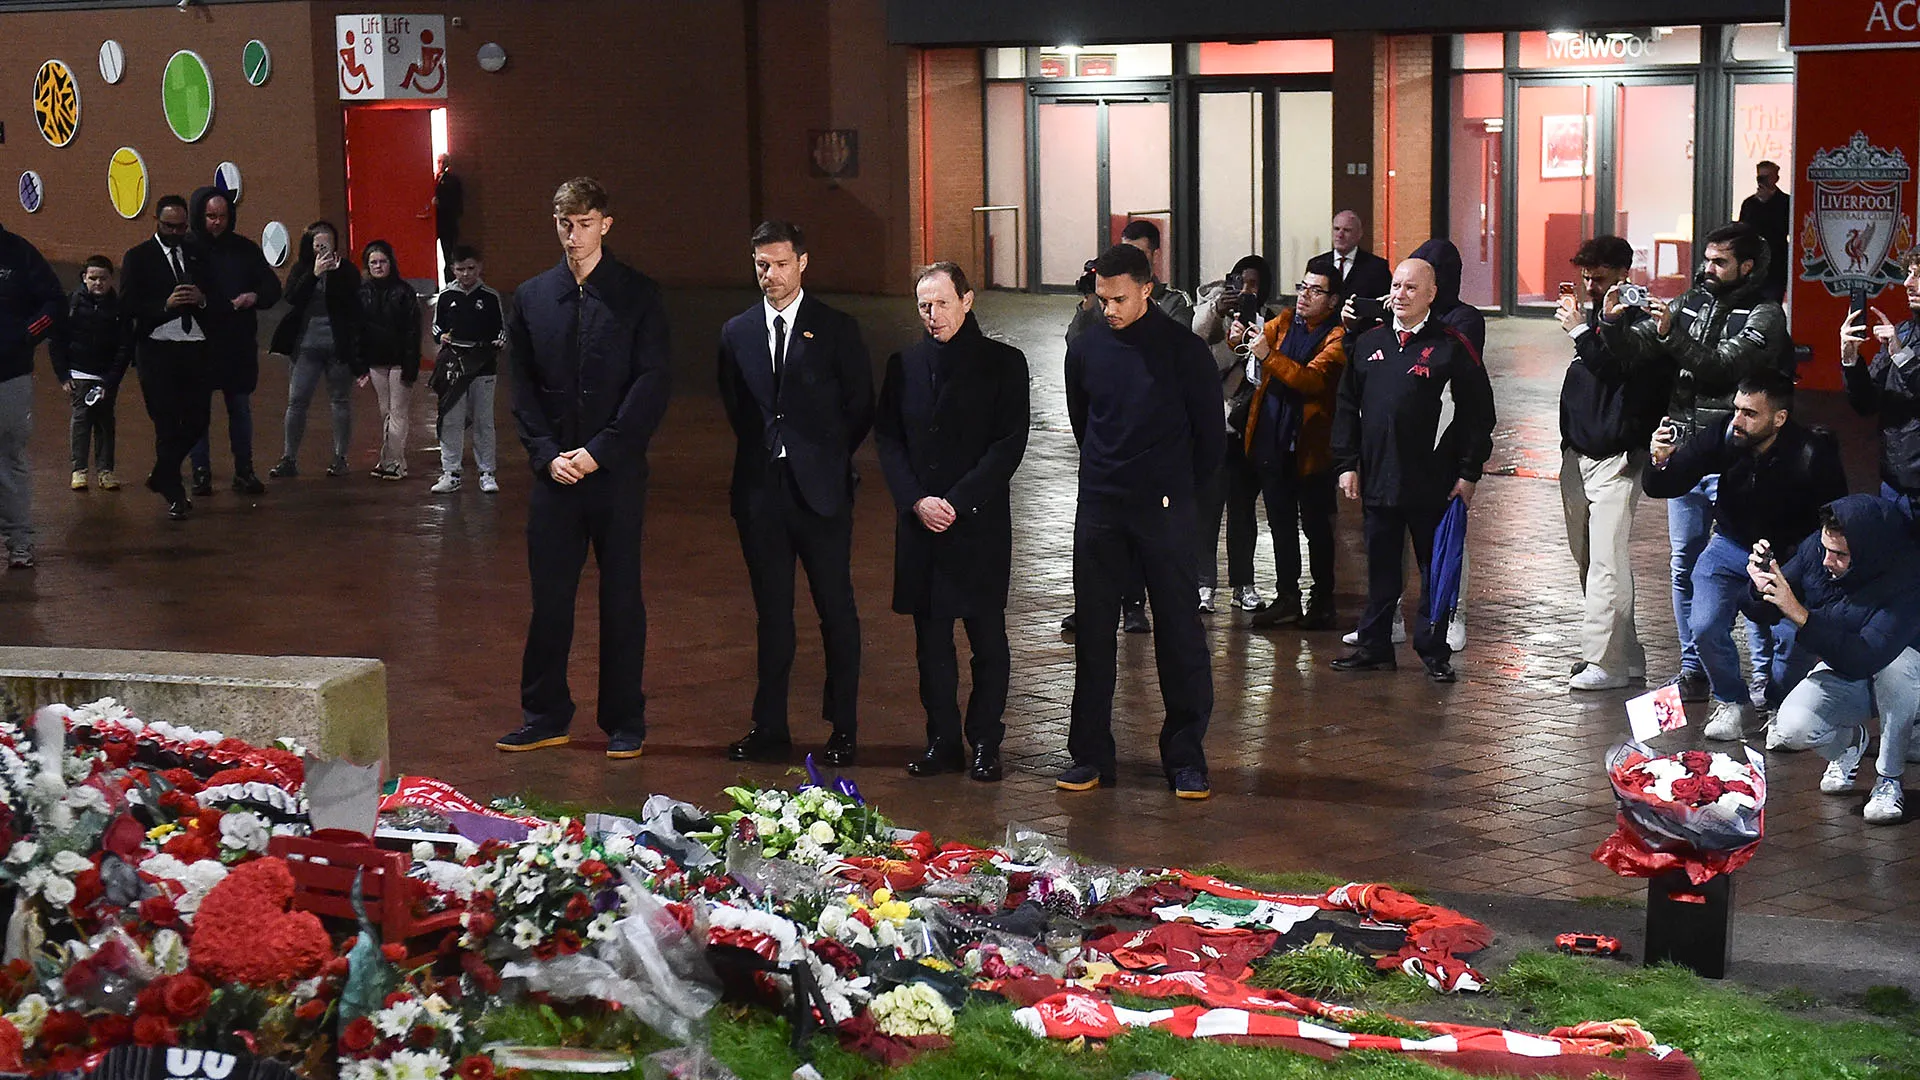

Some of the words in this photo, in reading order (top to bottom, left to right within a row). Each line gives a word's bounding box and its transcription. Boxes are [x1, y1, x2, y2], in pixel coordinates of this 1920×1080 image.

[1865, 1, 1920, 31] AC
[361, 17, 380, 34] Lift
[384, 17, 411, 34] Lift
[364, 37, 373, 55] 8
[387, 37, 400, 55] 8
[1821, 195, 1893, 210] LIVERPOOL
[403, 786, 469, 812] OTA
